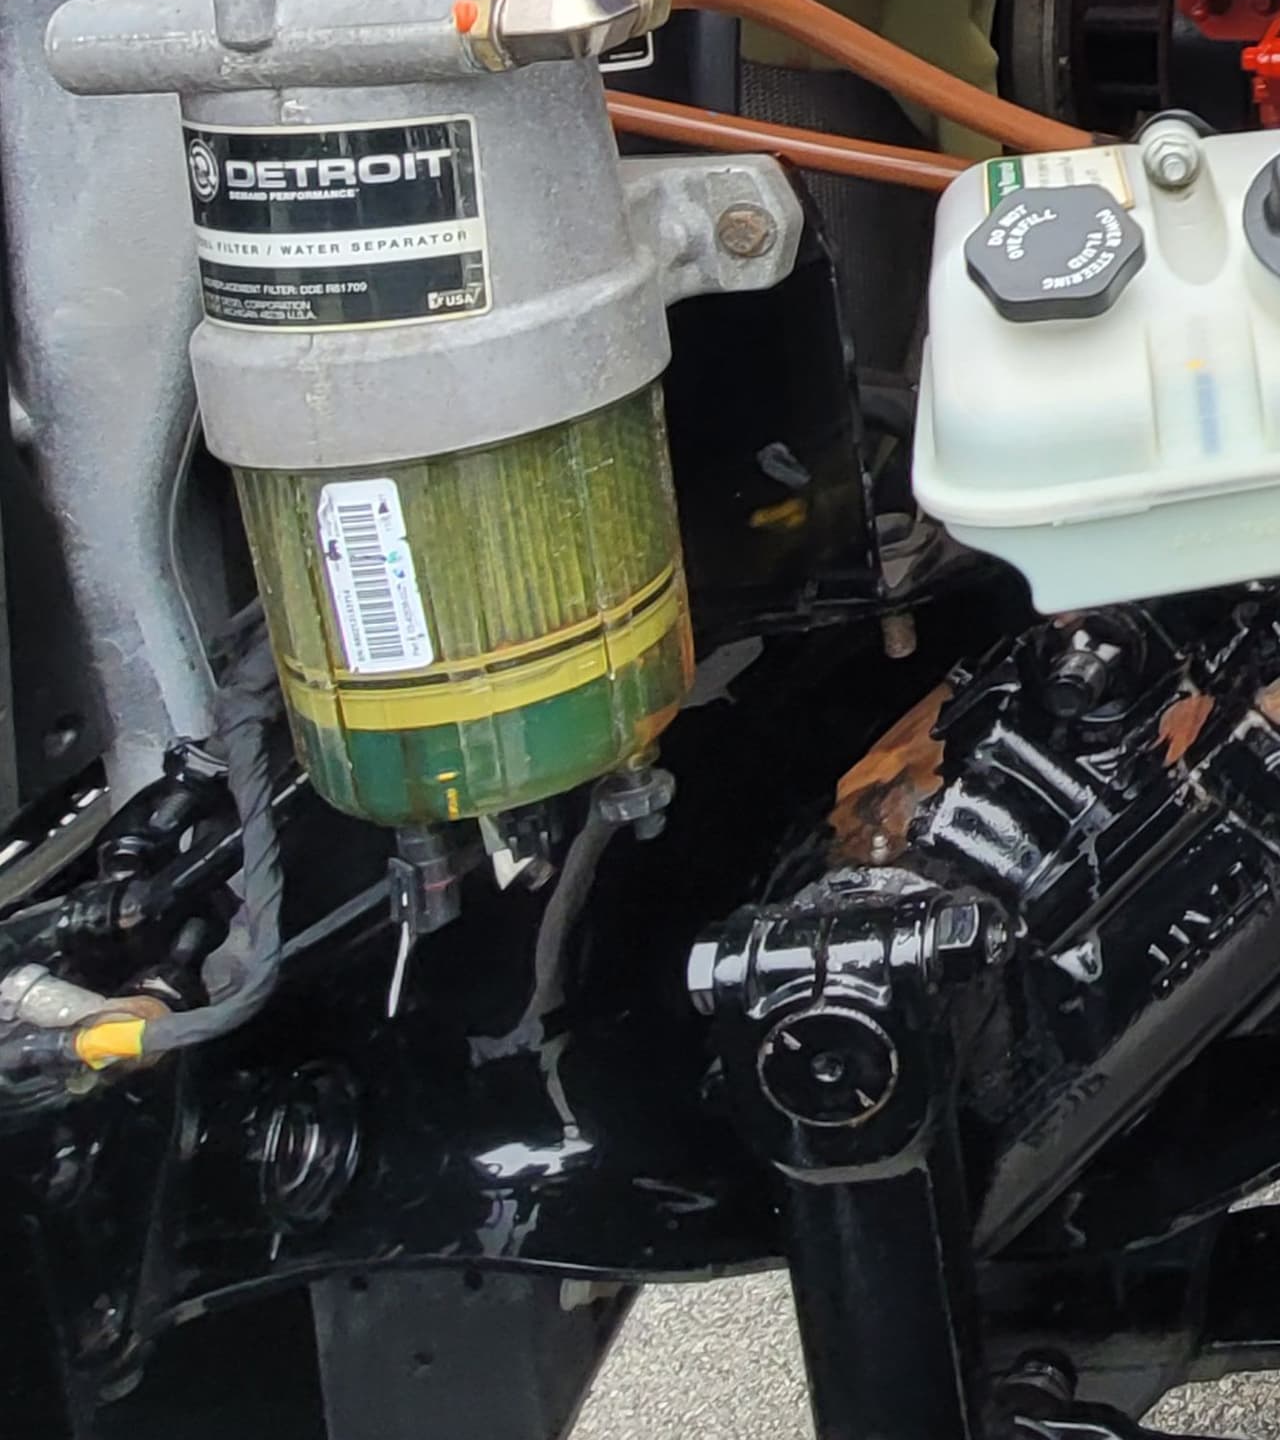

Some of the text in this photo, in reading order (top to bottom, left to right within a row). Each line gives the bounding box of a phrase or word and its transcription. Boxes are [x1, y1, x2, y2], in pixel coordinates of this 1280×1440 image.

[225, 149, 452, 189] DETROIT
[269, 188, 356, 202] PERFORMANCE
[217, 241, 260, 256] FILTER
[279, 243, 341, 256] WATER
[351, 230, 468, 253] SEPARATOR
[987, 229, 1006, 246] DO
[1006, 209, 1057, 260] OVERFILL
[1042, 209, 1122, 290] POWER STEERING
[1067, 232, 1103, 270] FLUID
